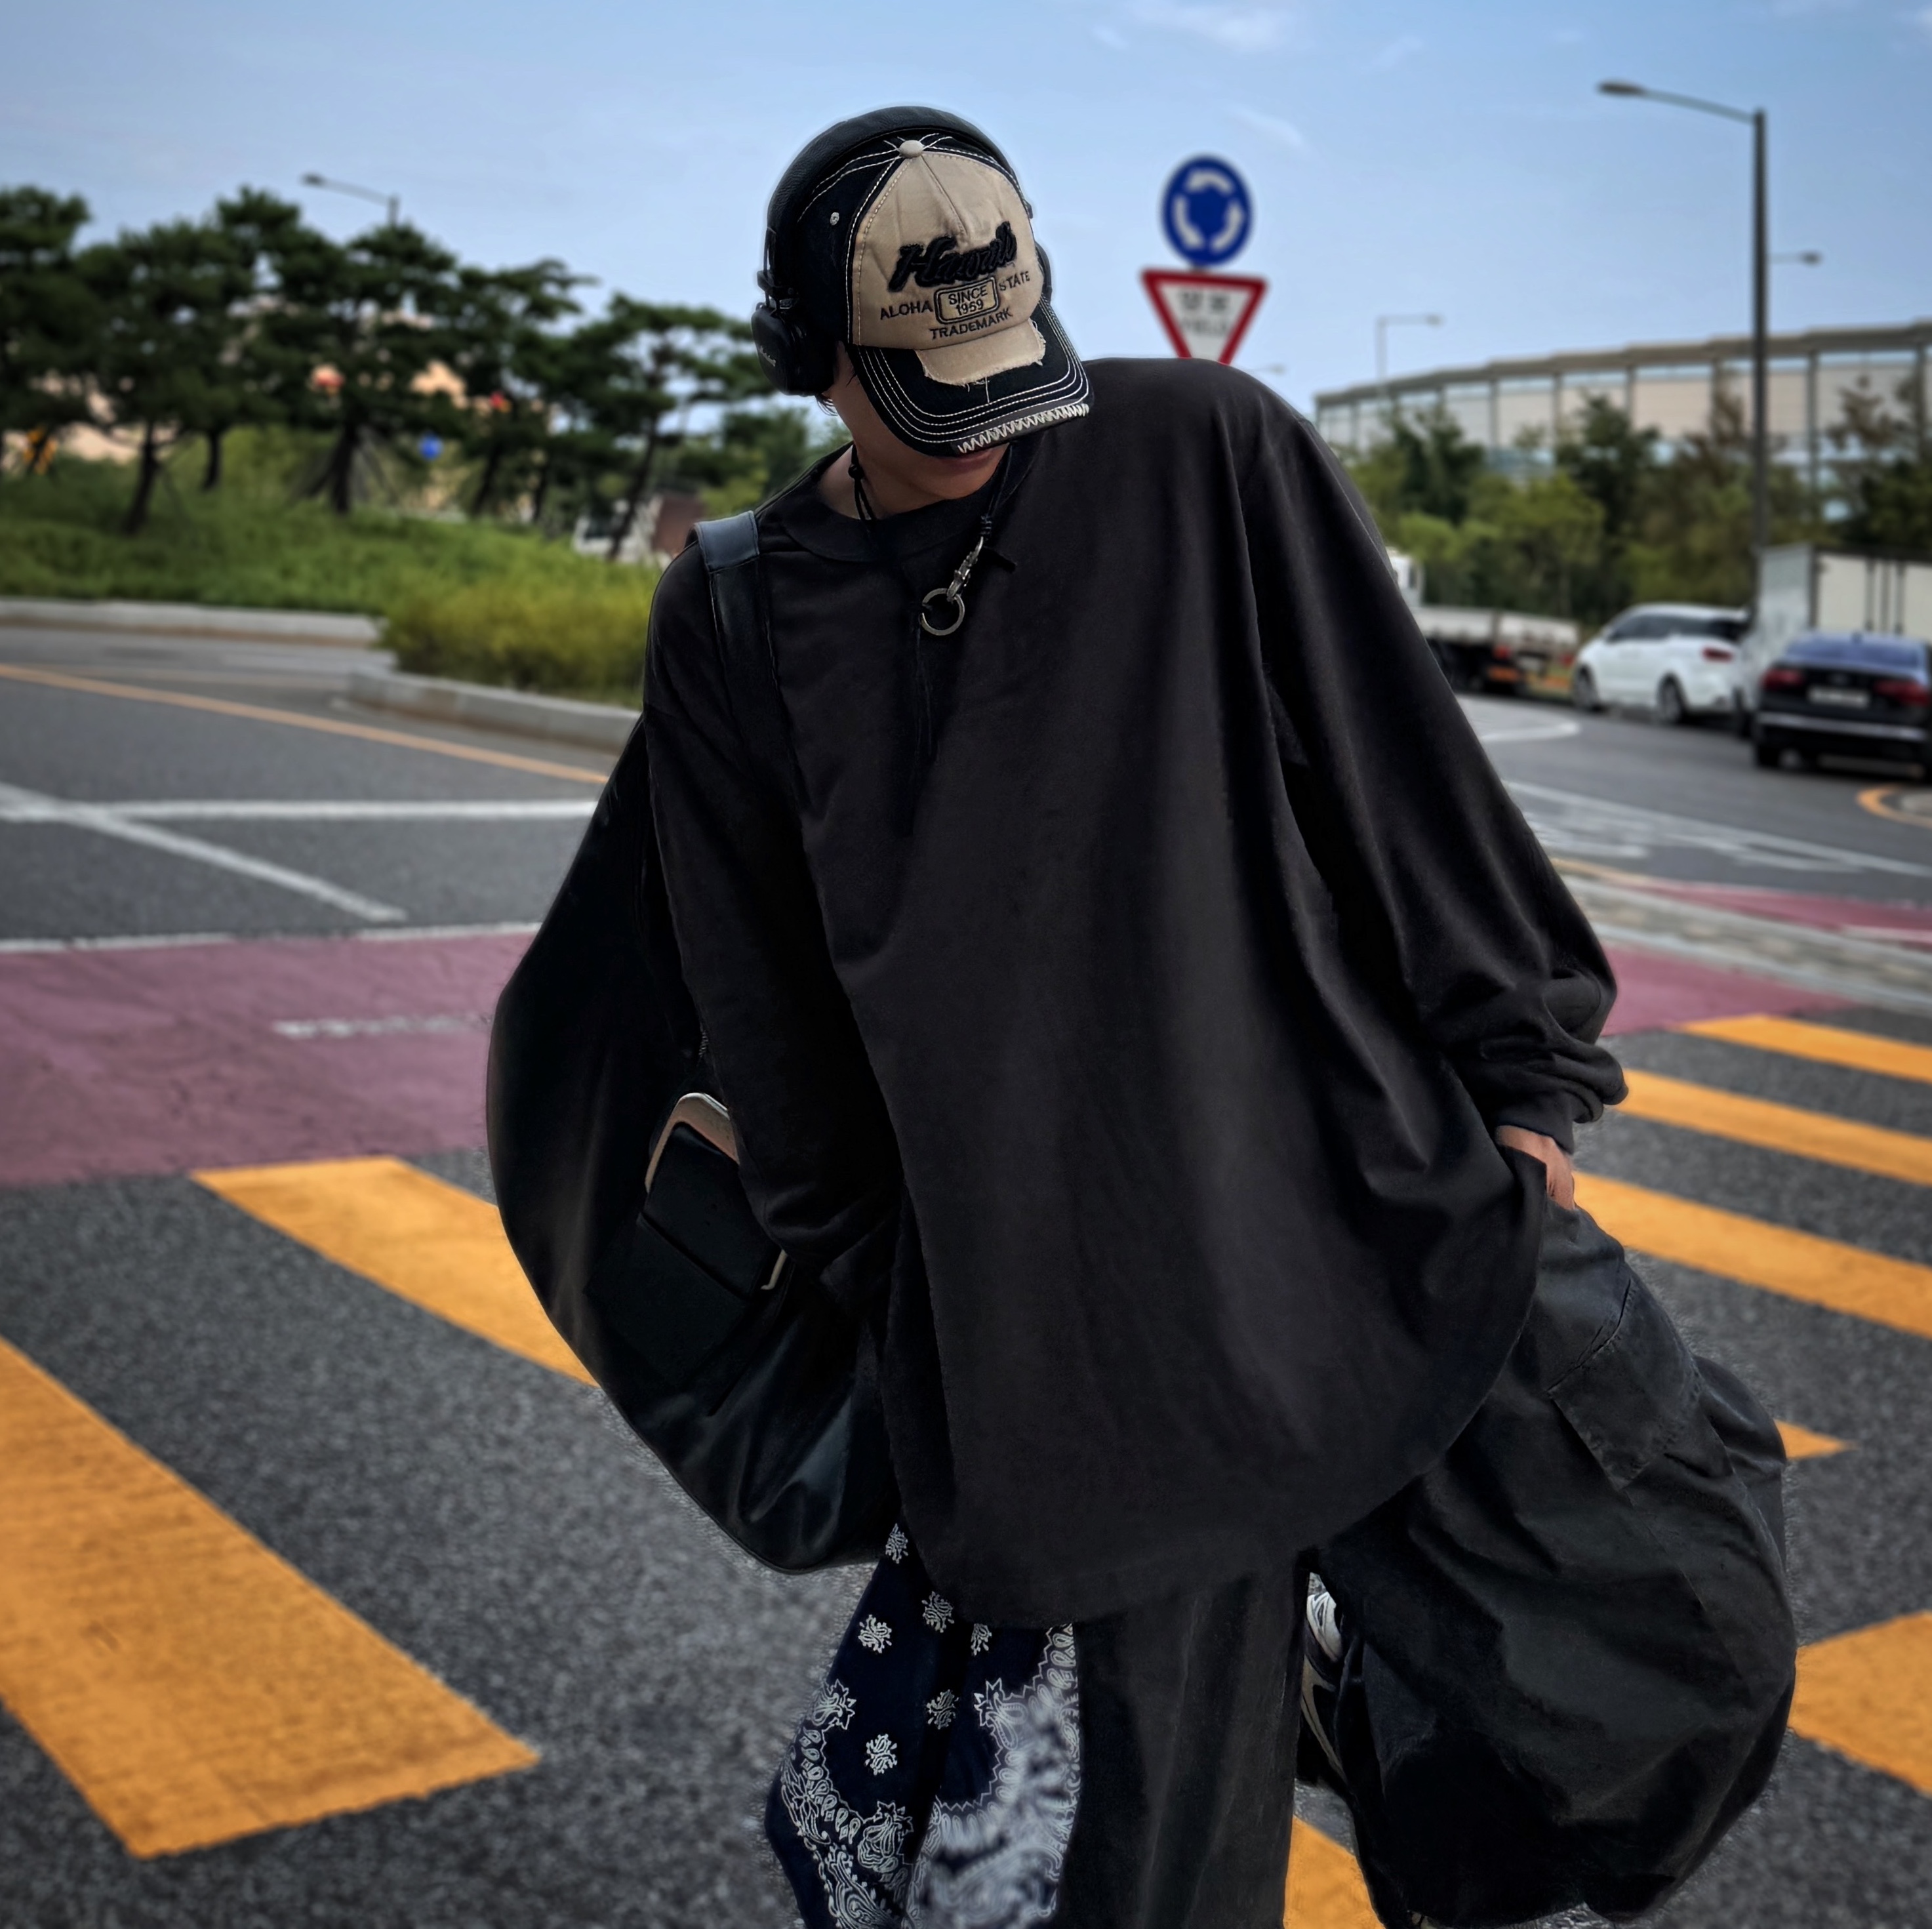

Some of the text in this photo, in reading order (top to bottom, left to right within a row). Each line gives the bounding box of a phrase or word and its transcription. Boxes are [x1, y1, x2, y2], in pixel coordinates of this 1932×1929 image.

[880, 271, 1030, 320] ALOHA STATE
[948, 285, 988, 305] SINCE
[929, 308, 1013, 340] TRADEMARK
